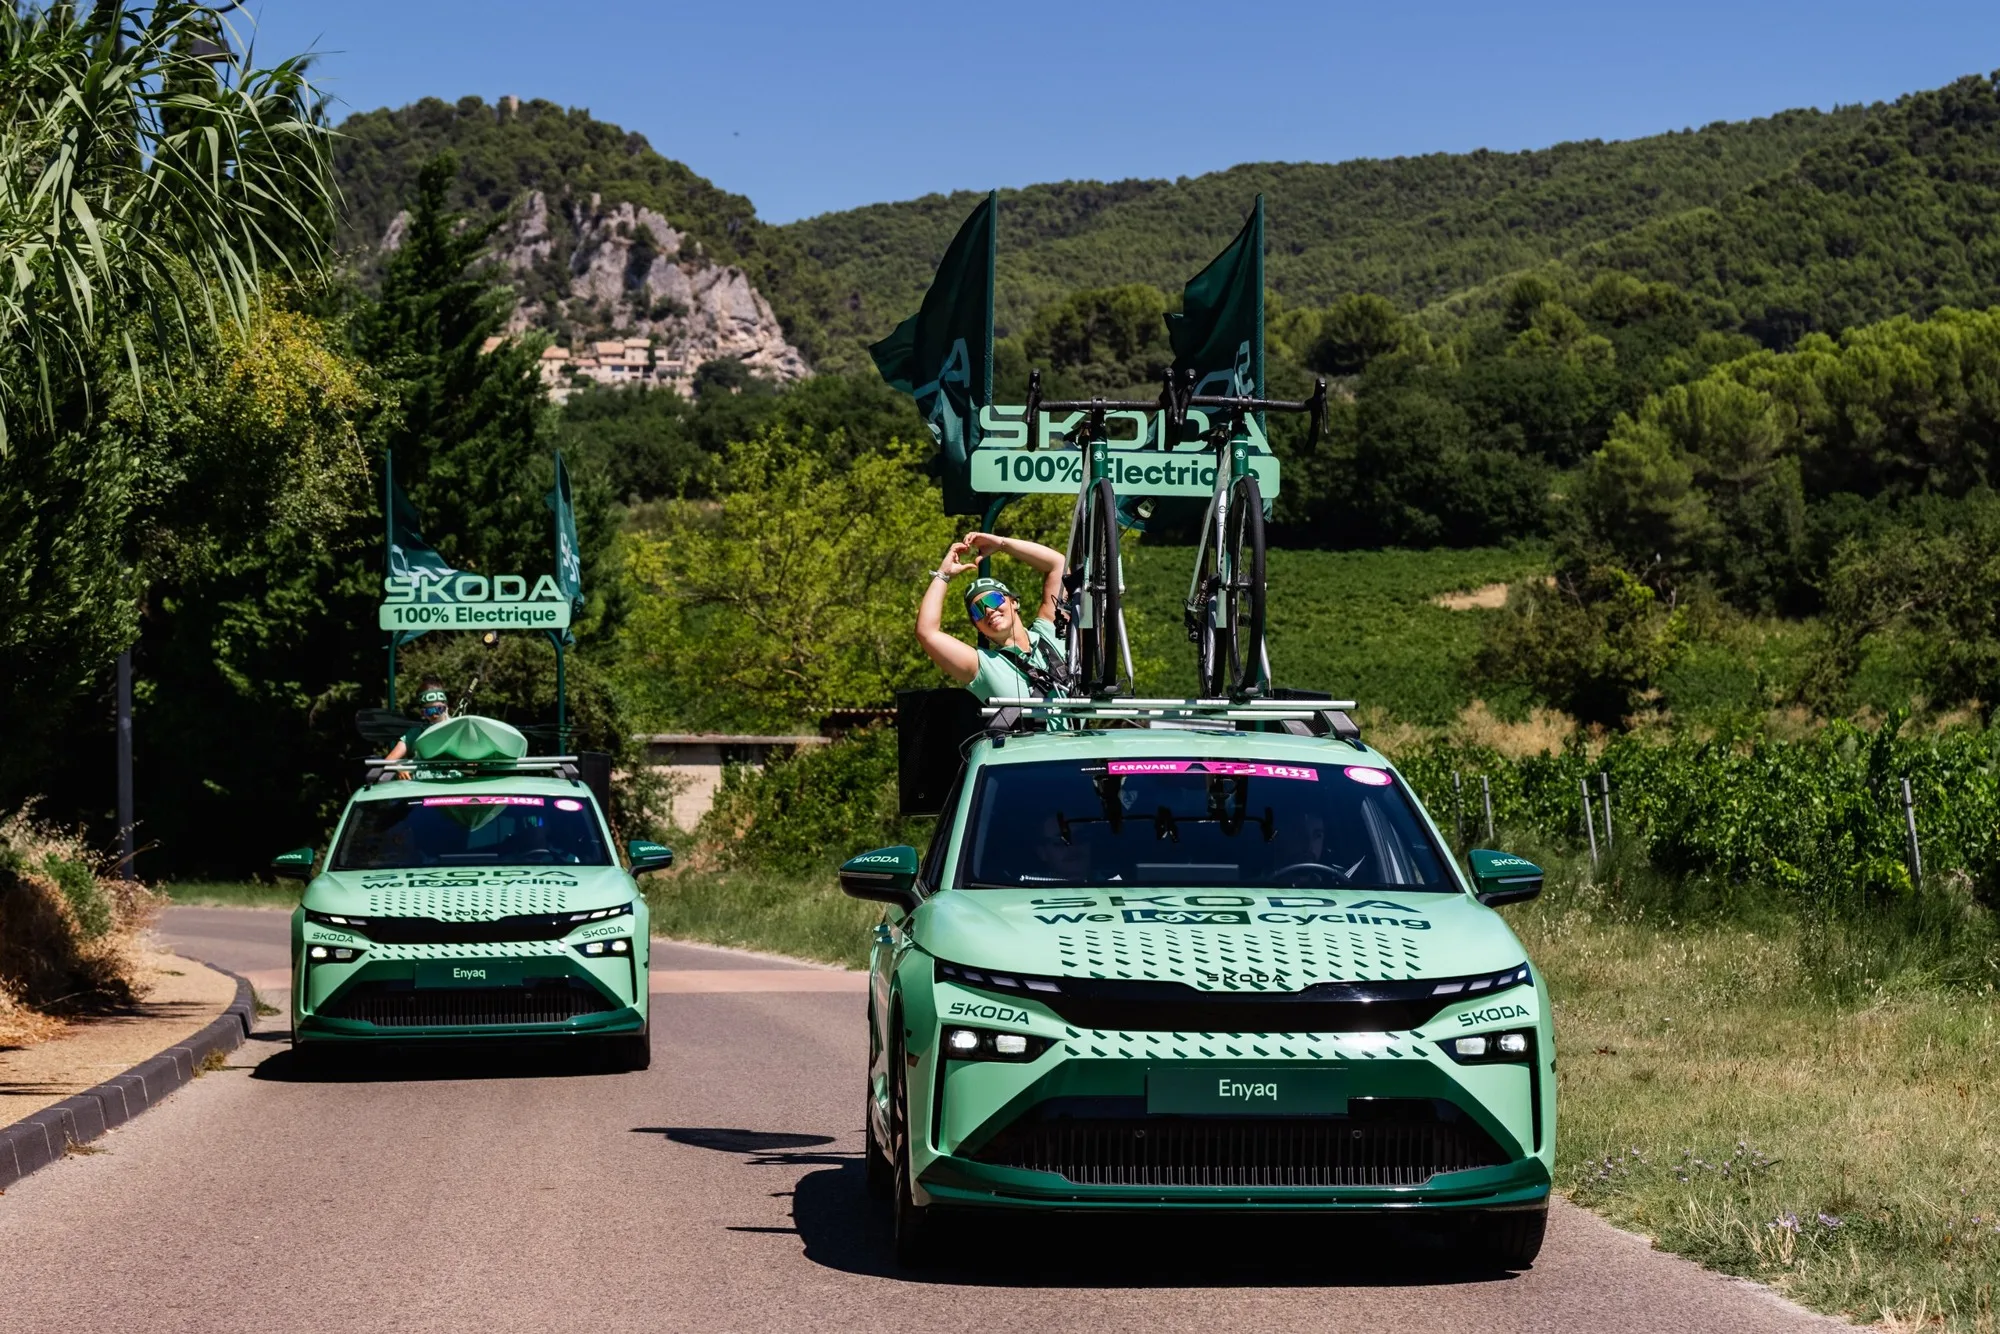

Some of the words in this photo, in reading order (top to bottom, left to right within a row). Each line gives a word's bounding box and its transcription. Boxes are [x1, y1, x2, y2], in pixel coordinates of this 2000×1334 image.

[994, 455, 1083, 483] 100%
[1106, 457, 1260, 493] lectriq
[384, 574, 565, 603] SKODA
[393, 607, 449, 623] 100%
[456, 606, 557, 626] Electrique
[1263, 766, 1311, 778] 1433
[853, 855, 900, 864] SKODA
[361, 870, 576, 882] SKODA
[361, 881, 404, 889] We
[483, 878, 578, 887] Cycling
[1030, 895, 1423, 913] SKODA
[1033, 912, 1115, 925] We
[1131, 910, 1240, 923] Love
[1257, 912, 1432, 930] Cycling
[312, 932, 354, 944] SKODA
[582, 925, 626, 939] SKODA
[453, 967, 486, 980] Enyaq
[1206, 973, 1287, 983] SKODA
[948, 1002, 1030, 1025] SKODA
[1457, 1004, 1530, 1028] SKODA
[1218, 1079, 1278, 1101] Enyaq
